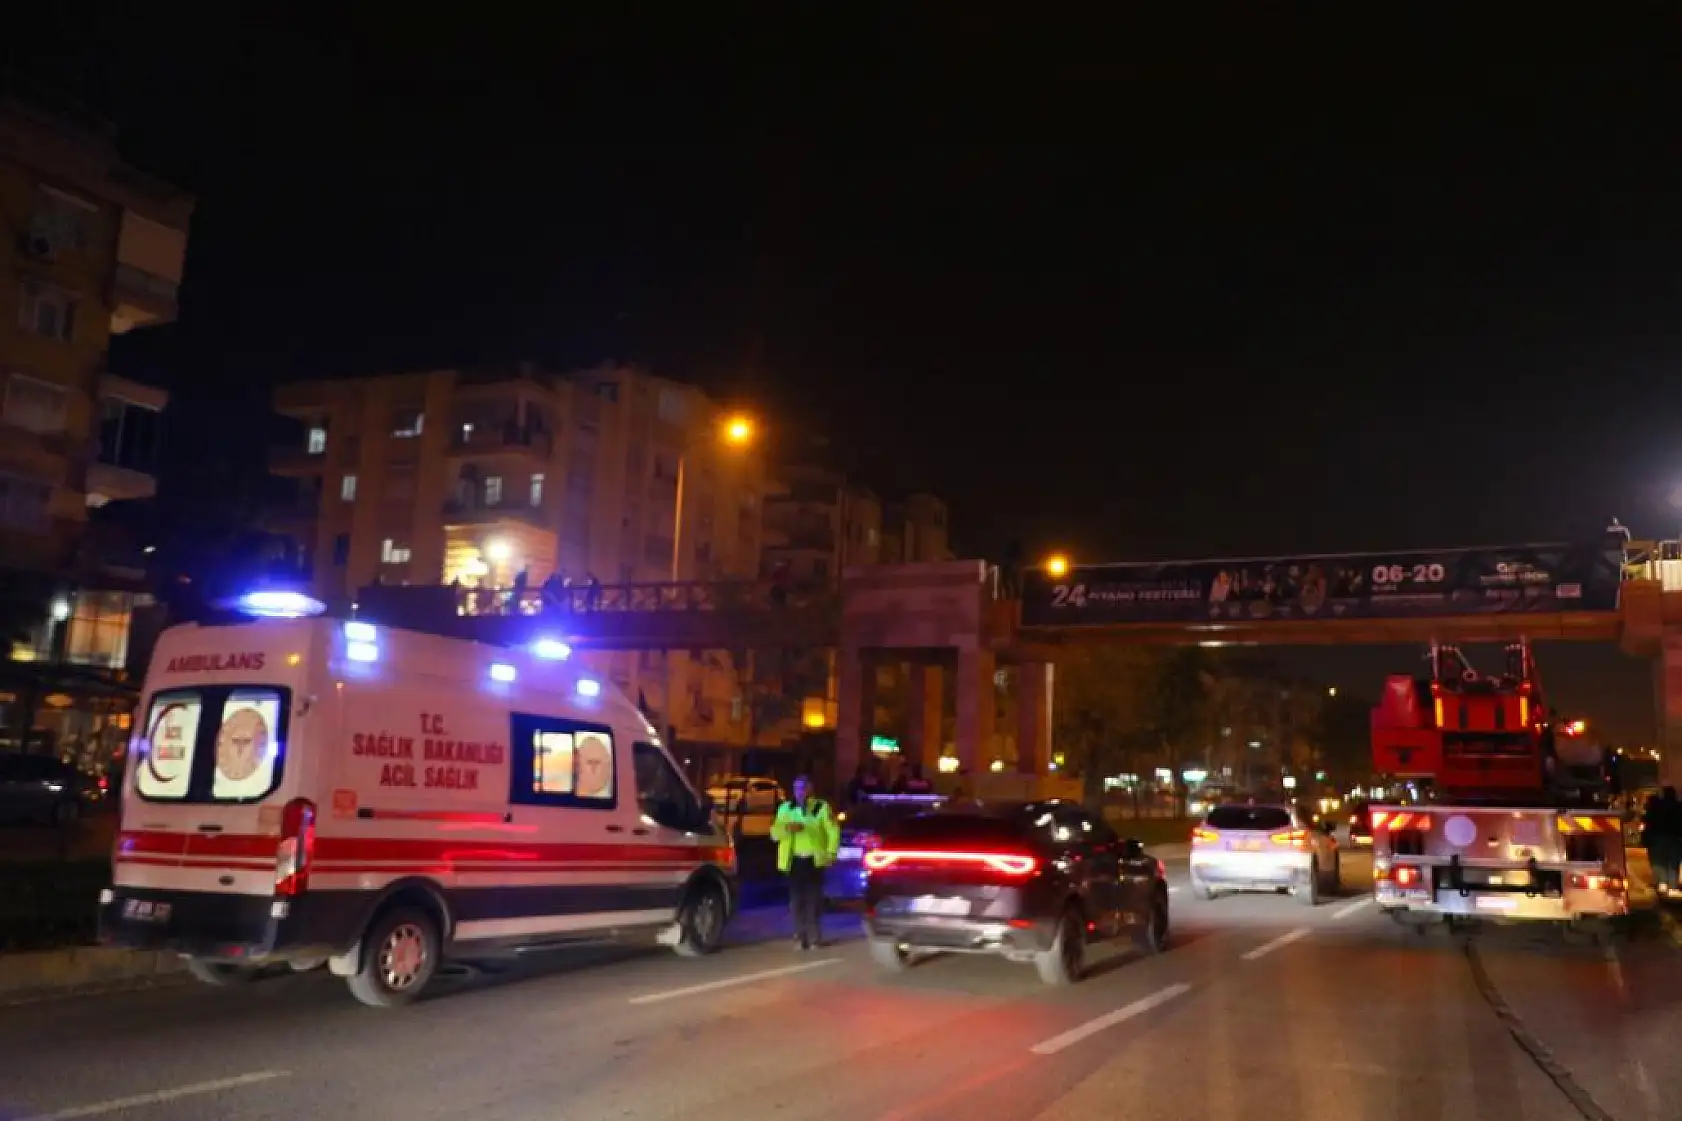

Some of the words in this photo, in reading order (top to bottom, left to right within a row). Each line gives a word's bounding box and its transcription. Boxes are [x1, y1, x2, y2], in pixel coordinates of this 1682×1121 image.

[1372, 564, 1445, 583] 06-20
[1051, 585, 1087, 607] 24
[166, 652, 265, 673] AMBULANS
[352, 728, 415, 758] SAĞLIK
[424, 739, 504, 764] BAKANLIĞI
[424, 765, 480, 789] SAĞLIK
